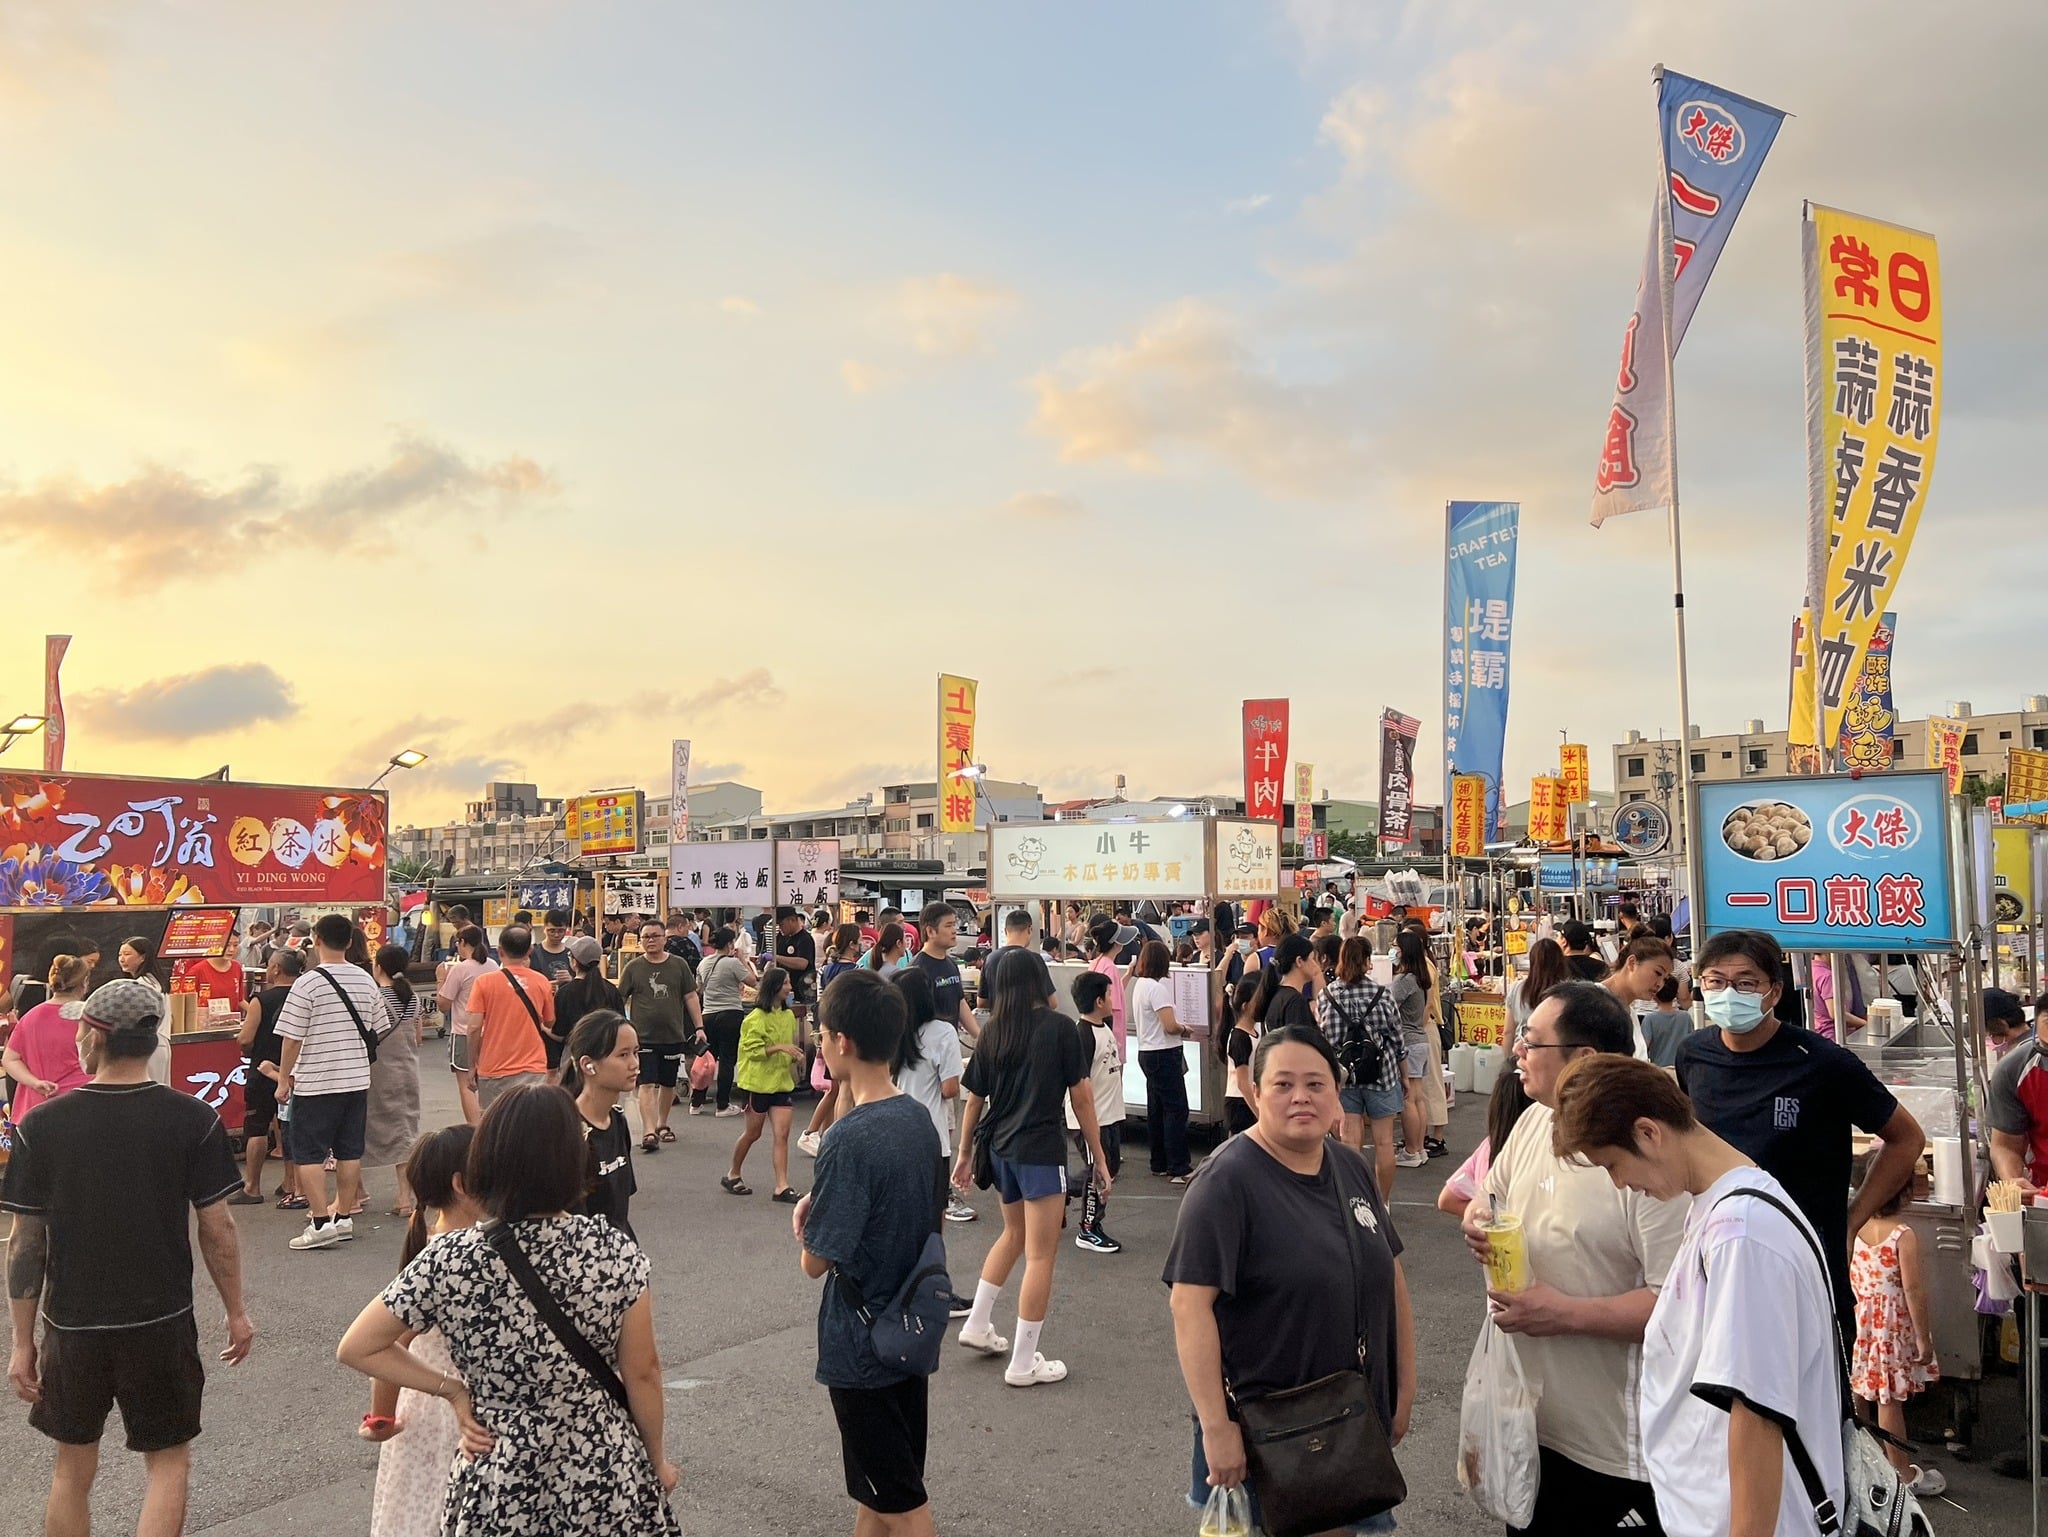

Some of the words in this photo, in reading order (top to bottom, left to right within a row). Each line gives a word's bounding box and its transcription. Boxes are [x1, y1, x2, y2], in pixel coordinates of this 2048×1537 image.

[1682, 108, 1735, 160] 大傑
[1449, 526, 1519, 560] CRAFTED
[1474, 551, 1508, 570] TEA
[1469, 598, 1511, 690] 堤霸
[1384, 772, 1411, 830] 肉骨茶
[1842, 807, 1910, 848] 大傑
[235, 826, 345, 860] 紅茶冰
[1096, 830, 1150, 854] 小牛
[1256, 846, 1273, 860] 小牛
[236, 872, 250, 883] YI
[257, 872, 287, 883] DING
[290, 872, 326, 883] WONG
[1063, 861, 1183, 882] 木瓜牛奶專賣
[1726, 873, 1926, 927] 一口煎餃
[1474, 1026, 1489, 1043] 胡
[1775, 1096, 1800, 1113] DES
[1774, 1111, 1797, 1128] IGN
